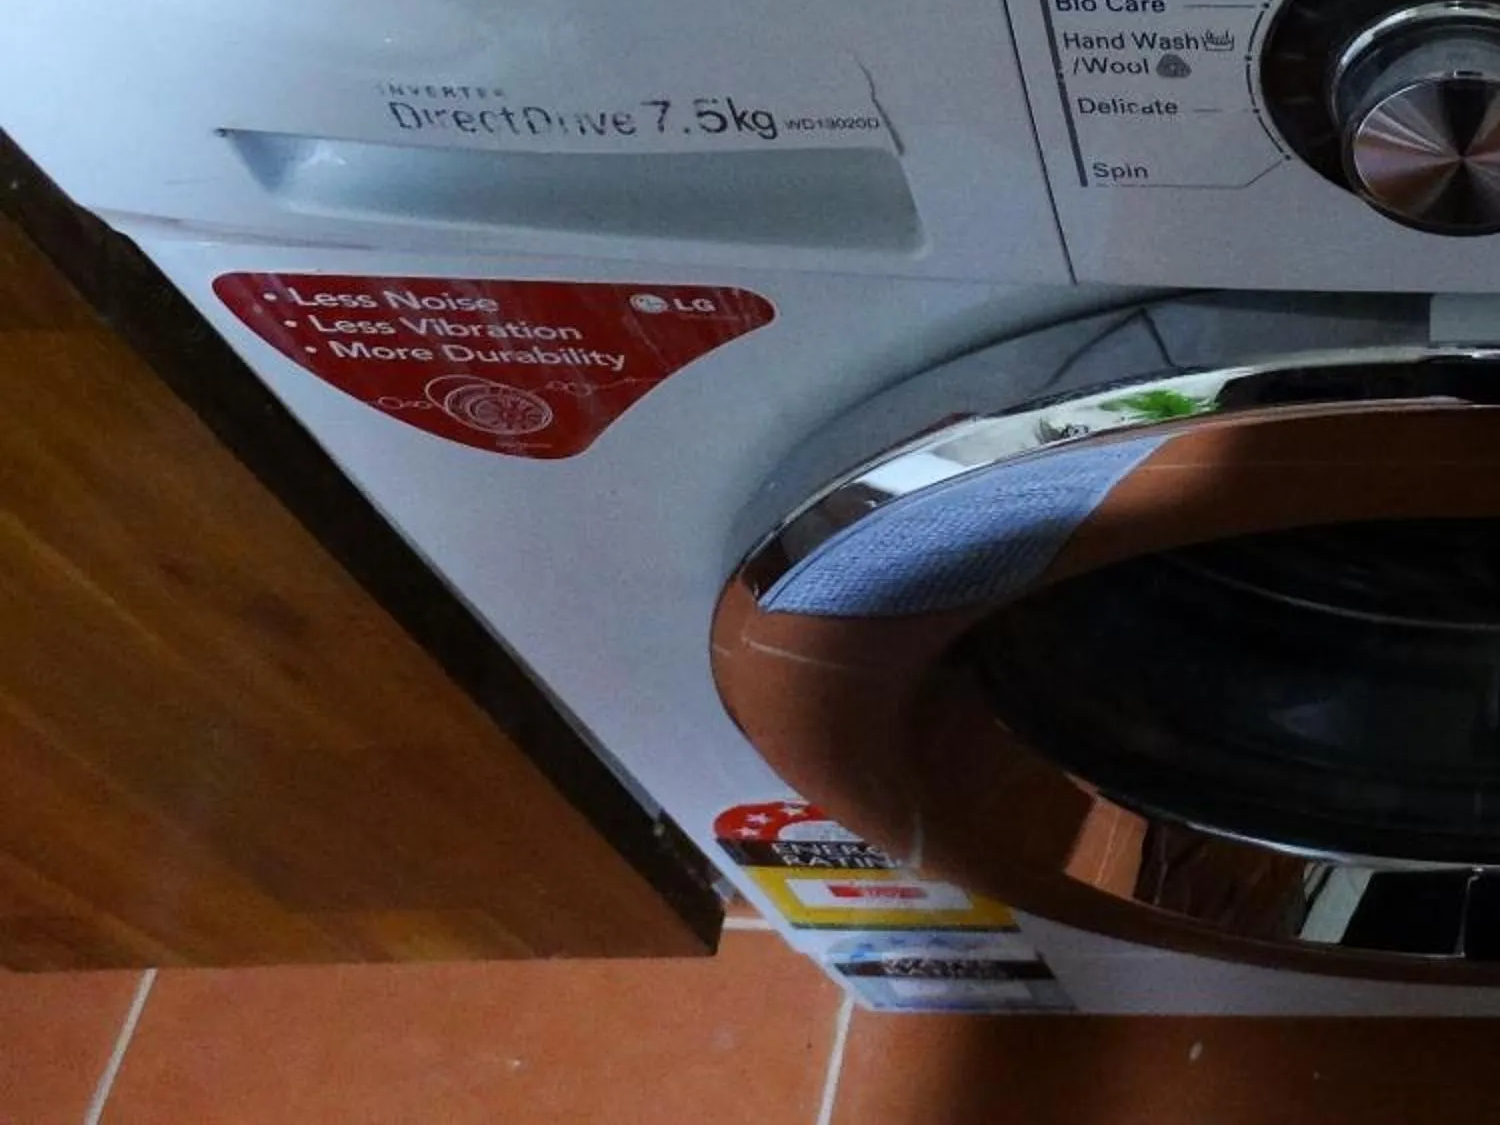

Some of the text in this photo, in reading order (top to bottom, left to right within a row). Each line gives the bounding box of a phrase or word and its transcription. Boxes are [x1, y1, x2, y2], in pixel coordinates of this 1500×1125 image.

[1063, 32, 1199, 50] Hand Wash
[1077, 97, 1178, 116] Delicate
[648, 97, 779, 140] 7.5kg
[1092, 162, 1149, 182] Spin
[287, 286, 498, 314] Less Noise
[673, 298, 716, 312] LG
[307, 314, 582, 340] Less Vibration
[327, 340, 626, 372] More Durability
